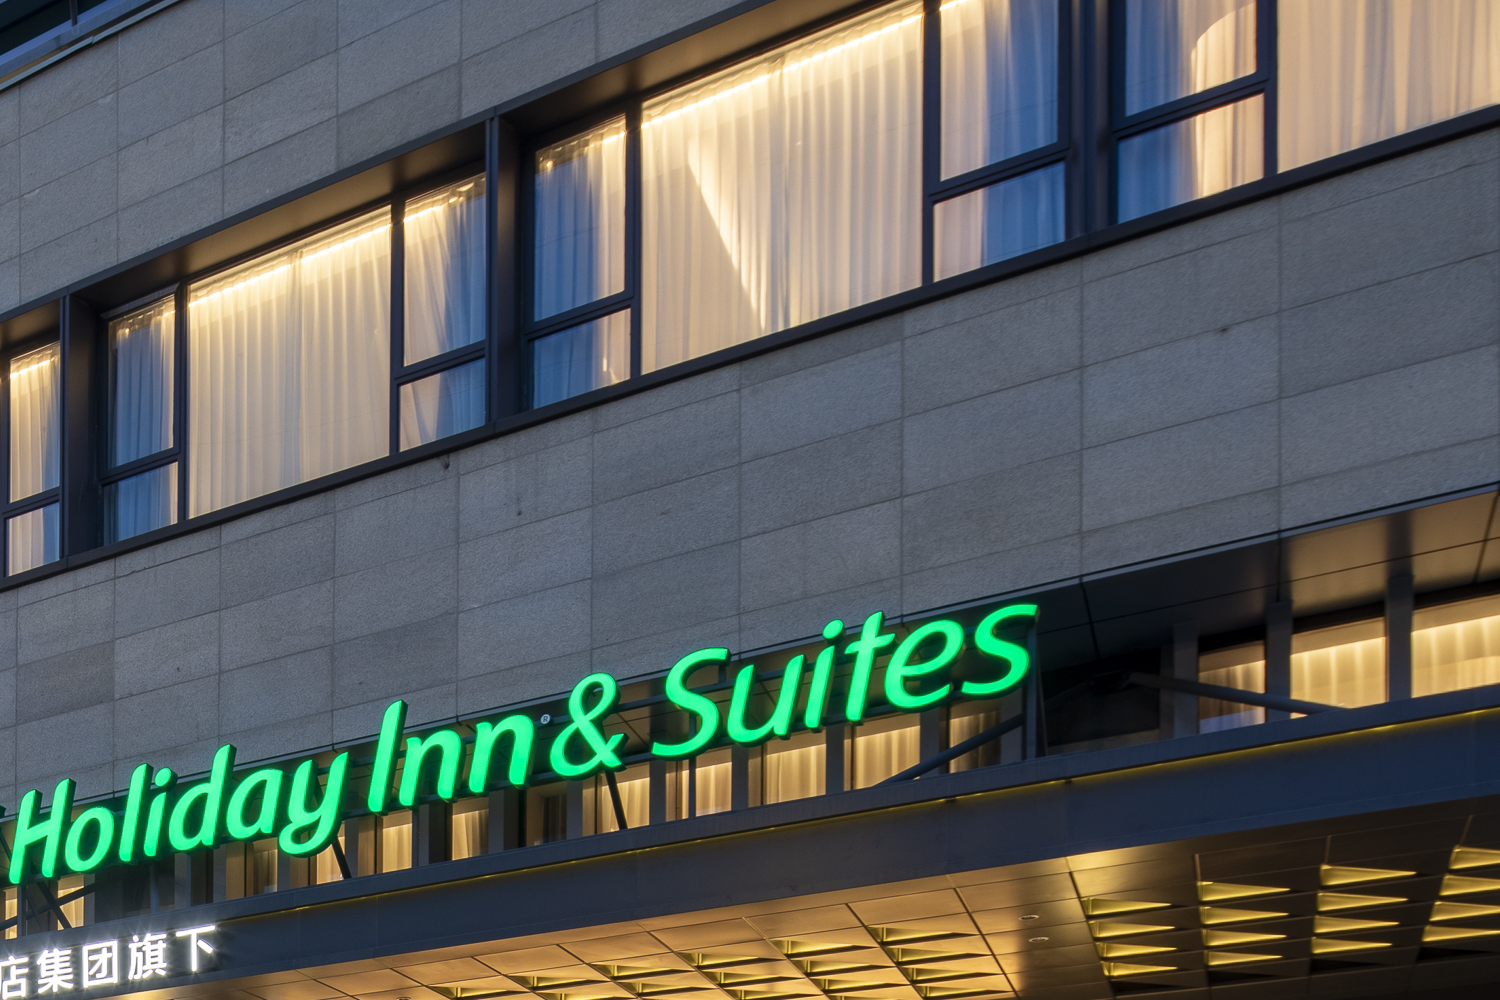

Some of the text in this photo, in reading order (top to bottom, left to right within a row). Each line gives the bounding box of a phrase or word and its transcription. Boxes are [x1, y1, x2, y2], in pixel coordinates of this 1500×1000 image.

[8, 604, 1038, 885] Holiday Inn & Suites
